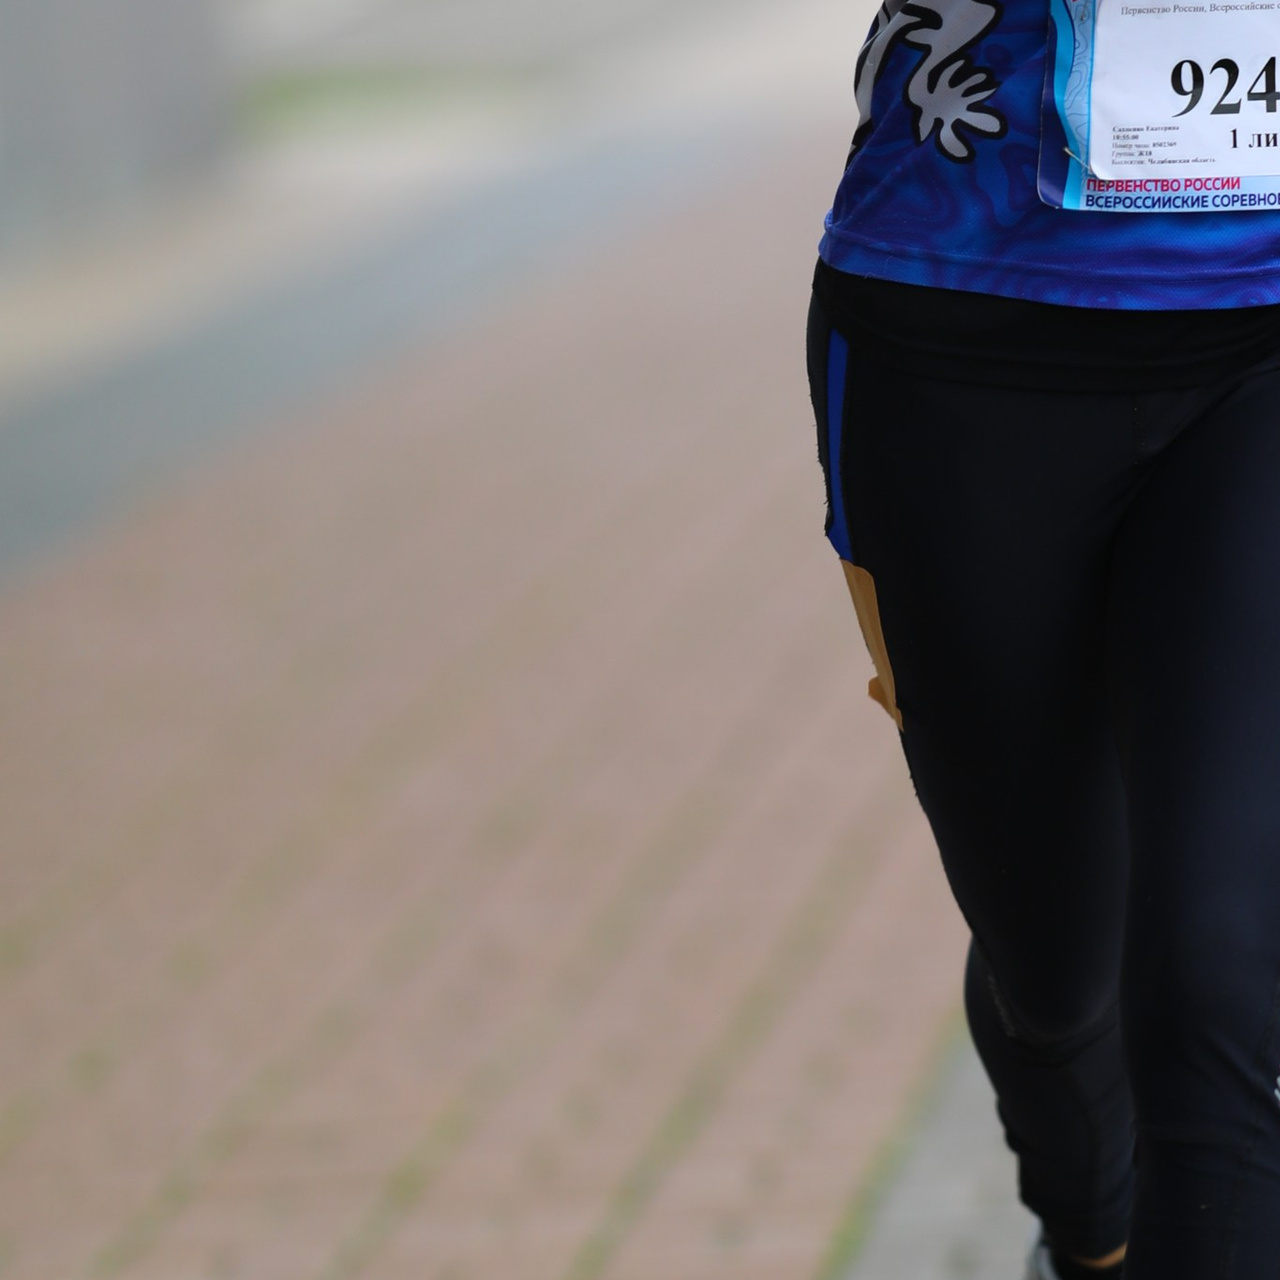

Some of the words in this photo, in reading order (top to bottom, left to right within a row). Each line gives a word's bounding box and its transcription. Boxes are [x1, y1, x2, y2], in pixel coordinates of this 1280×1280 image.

[1120, 6, 1171, 17] Первенство
[1173, 4, 1207, 14] России,
[1209, 2, 1275, 13] Всероссийские
[1170, 56, 1280, 118] 924
[1230, 128, 1238, 149] 1
[1086, 178, 1181, 192] ПЕРВЕНСТВО
[1184, 177, 1240, 191] РОССИИ
